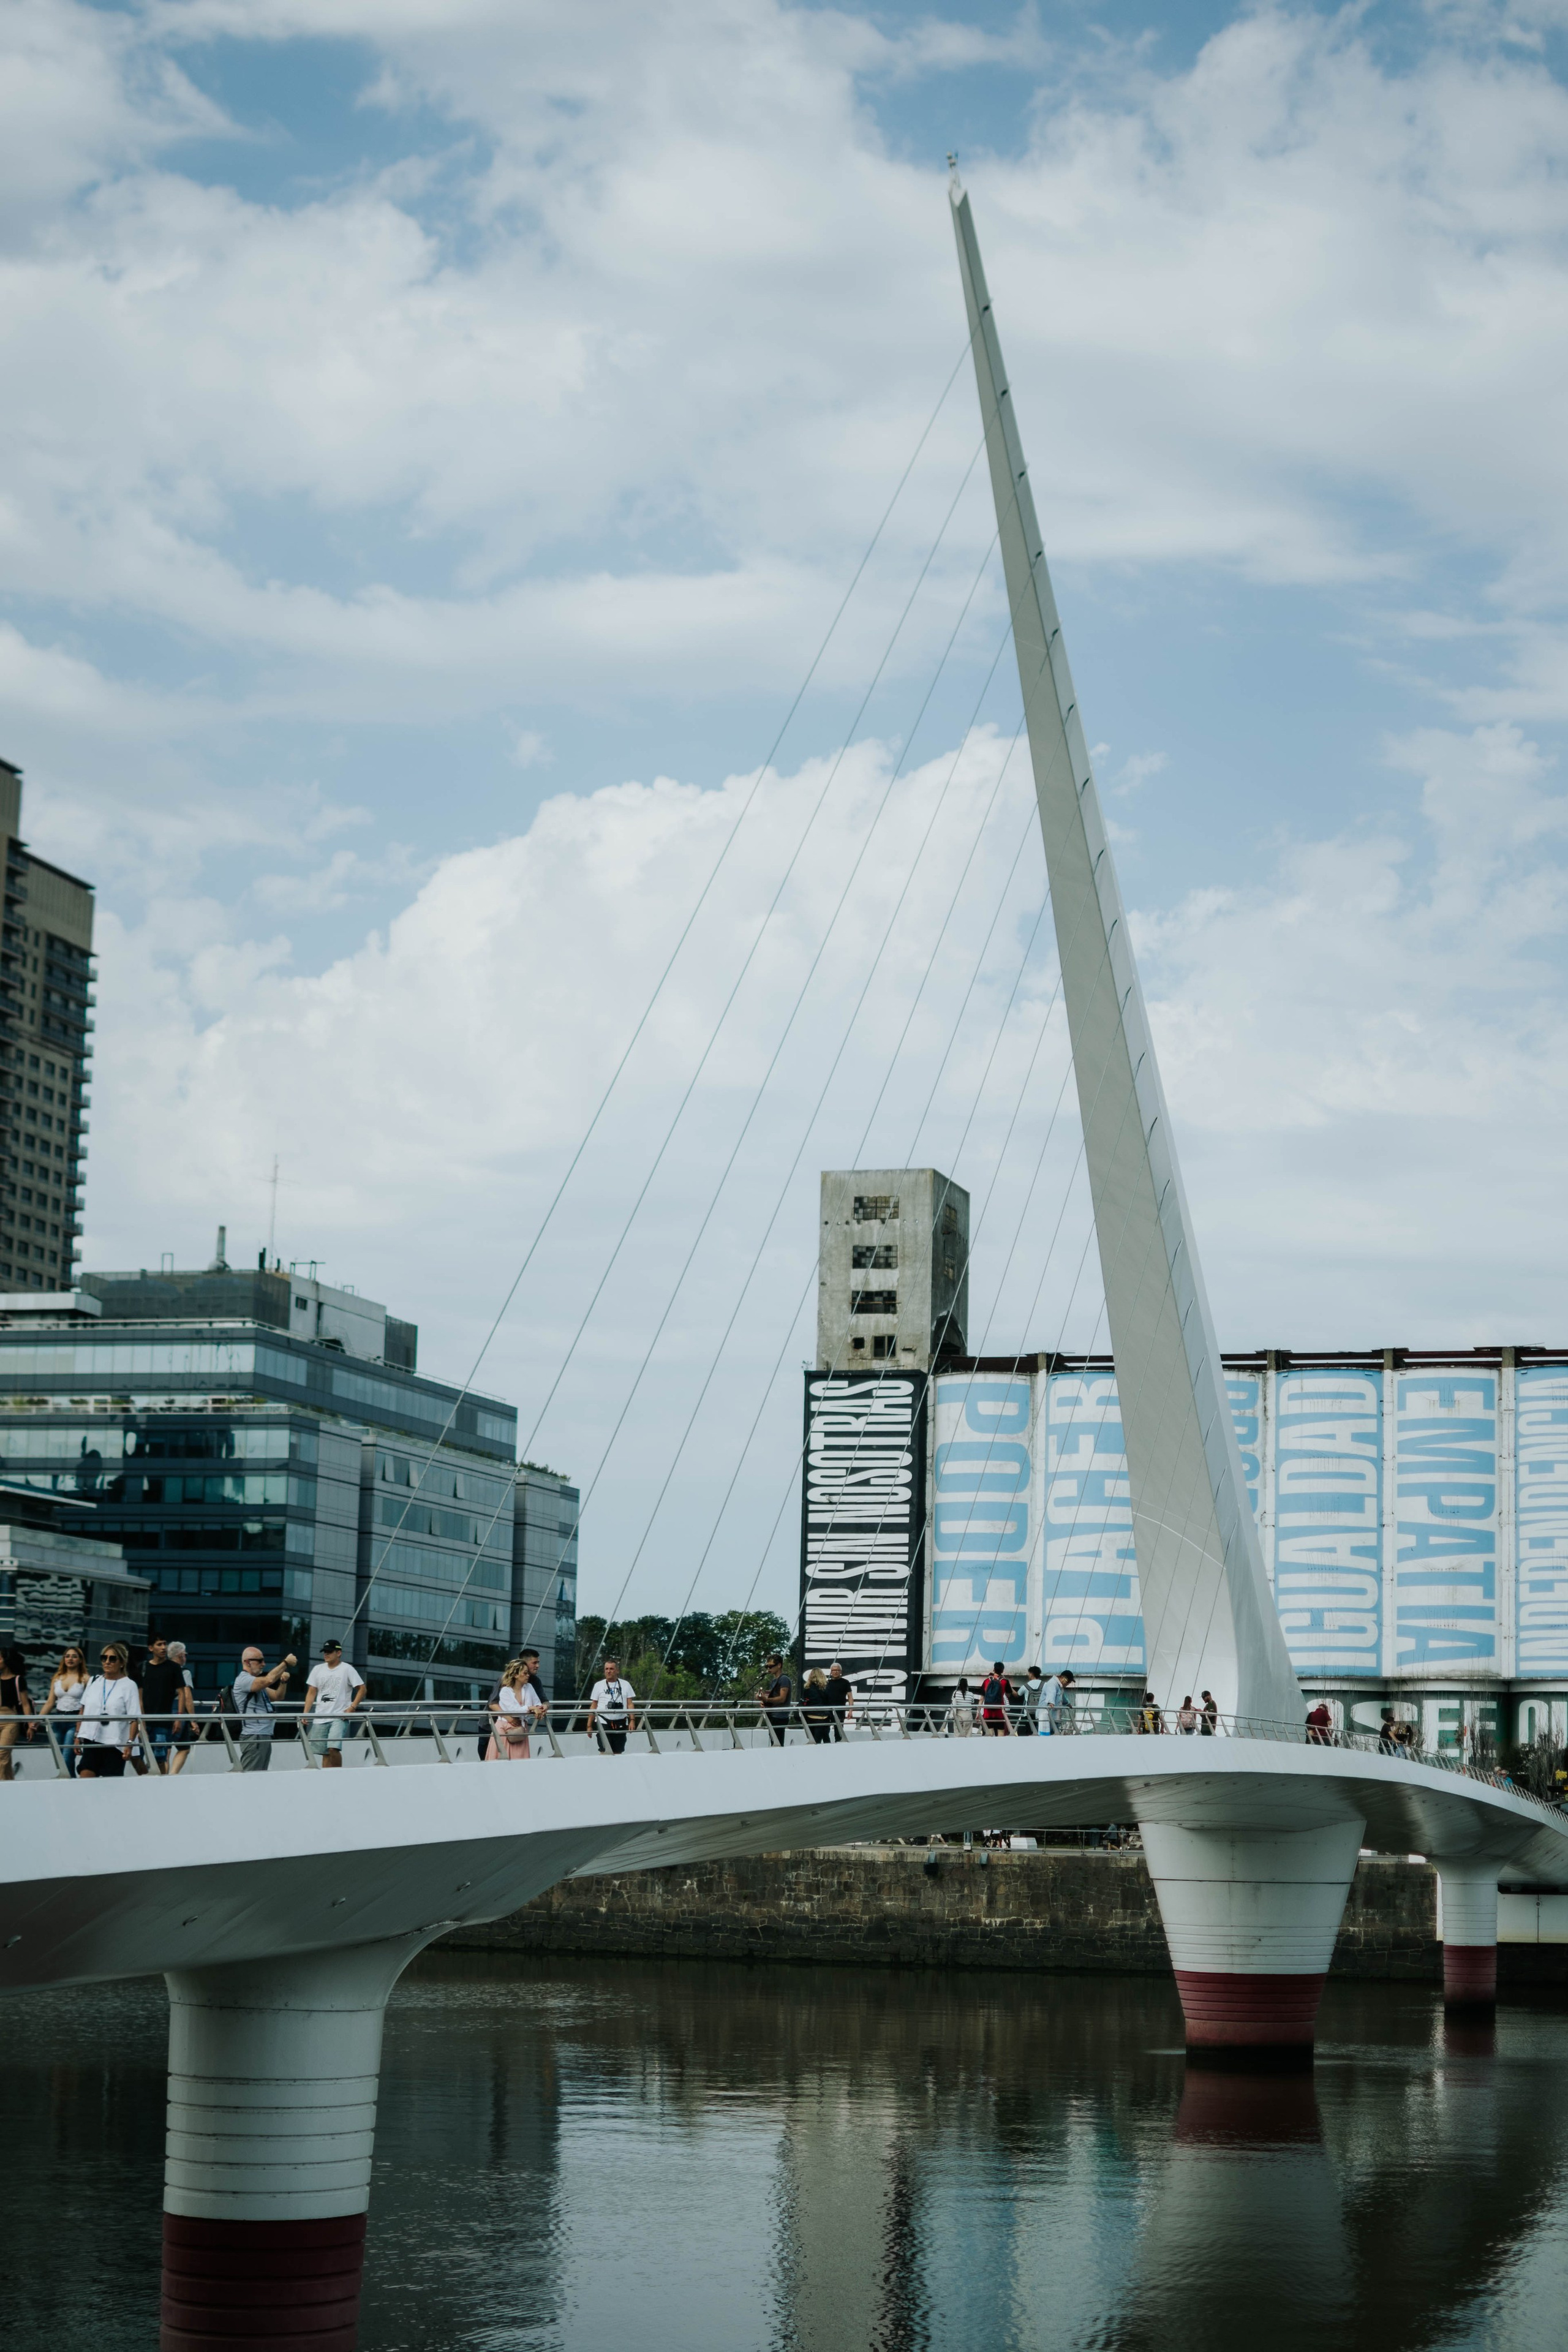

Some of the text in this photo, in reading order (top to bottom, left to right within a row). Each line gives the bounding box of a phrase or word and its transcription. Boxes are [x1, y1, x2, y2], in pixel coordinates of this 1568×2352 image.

[805, 1533, 910, 1579] SIN
[807, 1380, 914, 1523] NOSOTRAS
[932, 1382, 1031, 1664] PODER
[1045, 1378, 1144, 1665] PLACER
[1278, 1378, 1379, 1667] IGUALDAD
[1396, 1377, 1496, 1667] EMPATIA
[805, 1588, 908, 1660] VIVIR
